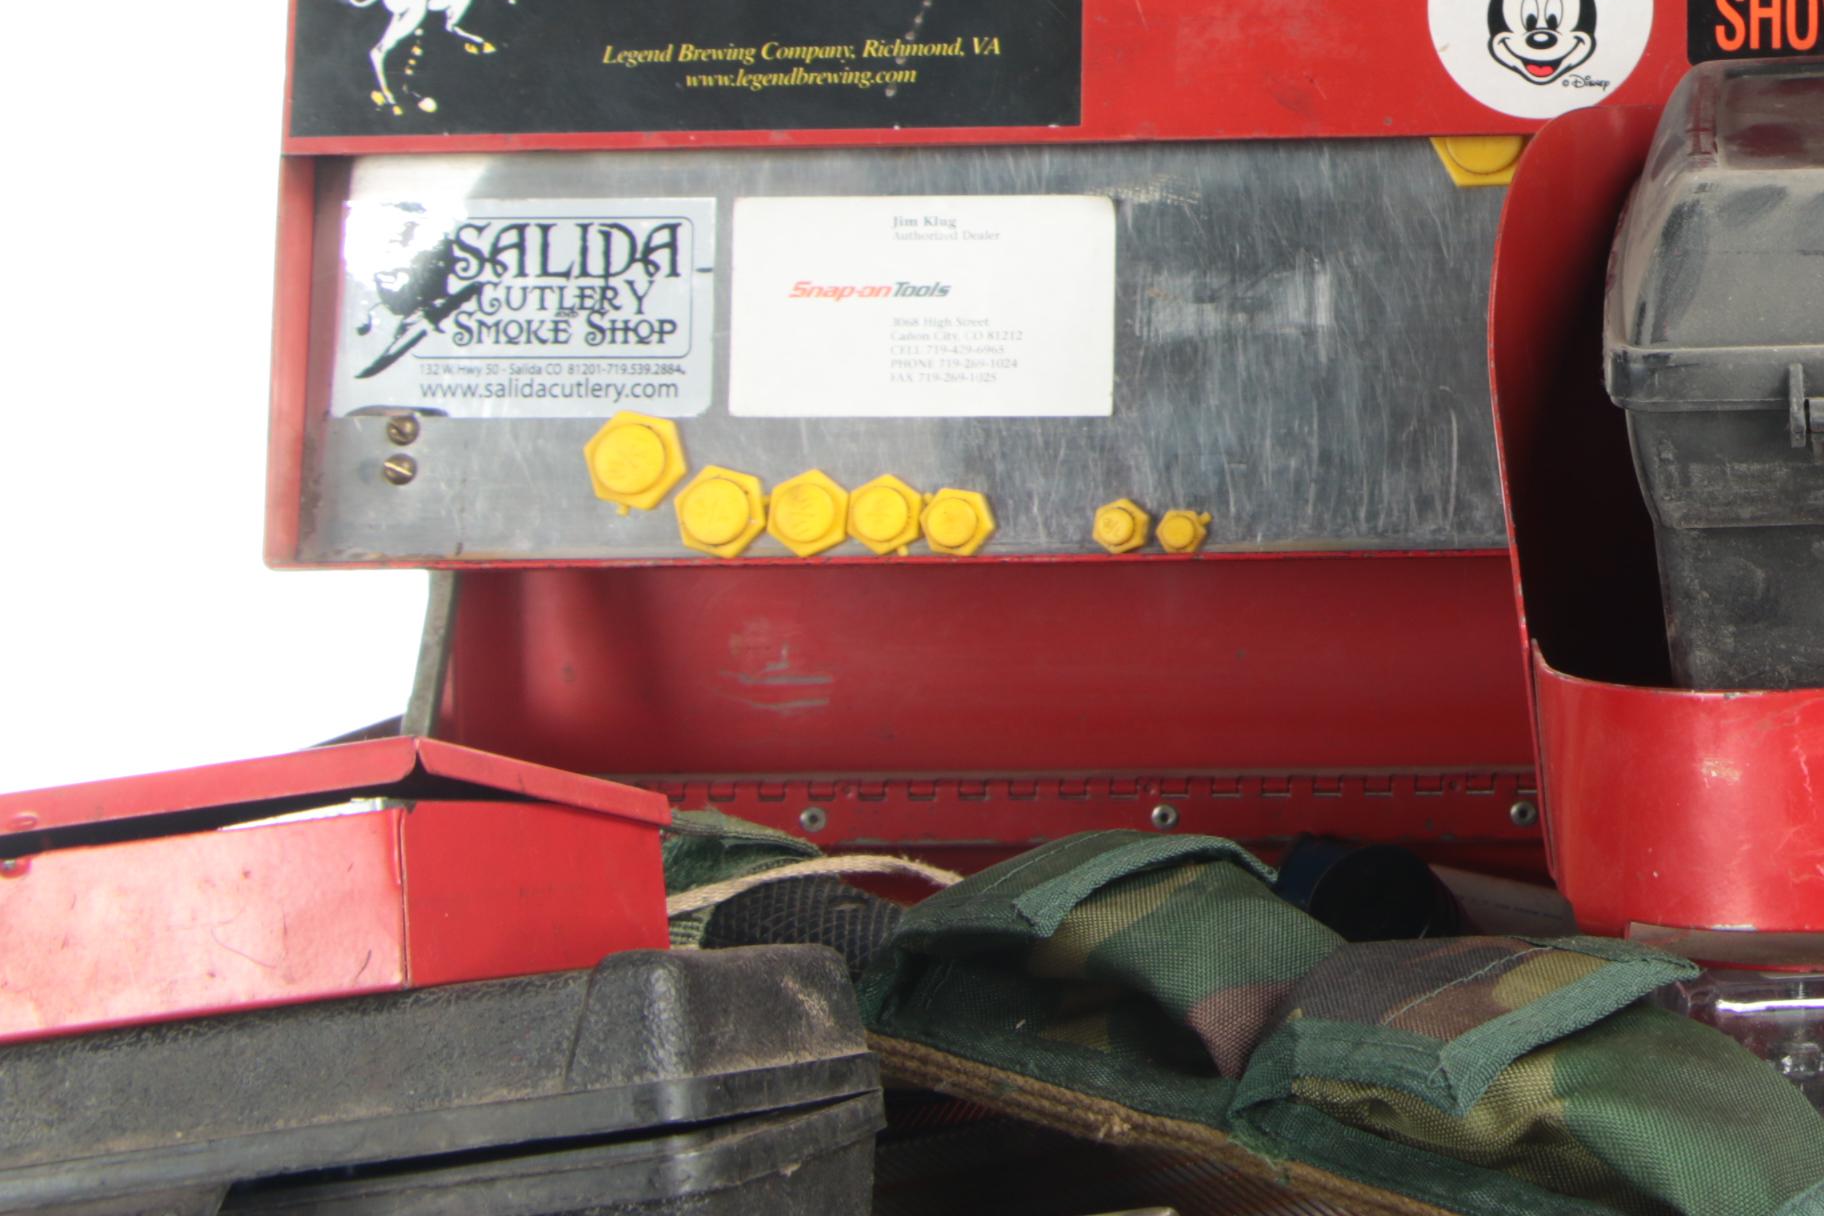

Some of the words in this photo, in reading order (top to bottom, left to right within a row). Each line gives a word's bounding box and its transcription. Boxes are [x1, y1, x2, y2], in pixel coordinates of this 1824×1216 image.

[602, 44, 673, 68] Legend
[677, 42, 756, 66] Brewing
[760, 41, 856, 64] Company,
[861, 37, 965, 59] Richmond,
[972, 36, 1001, 57] VA
[686, 67, 917, 91] www.legendbrewing.com
[1569, 74, 1610, 92] Disney
[893, 215, 919, 229] Jim
[893, 230, 958, 241] Authorized
[962, 230, 1001, 241] Dealer
[451, 222, 682, 281] SALIDA
[475, 279, 655, 316] CUTLERY
[788, 280, 893, 302] Snap-on
[892, 281, 952, 298] Tools
[453, 310, 573, 347] SMOKE
[584, 310, 677, 347] SHOP
[923, 316, 952, 329] High
[955, 316, 989, 328] Street
[986, 330, 1024, 342] 81212
[457, 364, 482, 378] Hwy
[485, 364, 500, 376] 50
[509, 363, 544, 376] Salida
[545, 364, 562, 376] CO
[890, 358, 934, 369] PHONE
[890, 372, 913, 384] FAX
[420, 377, 679, 403] www.salidacutlery.com
